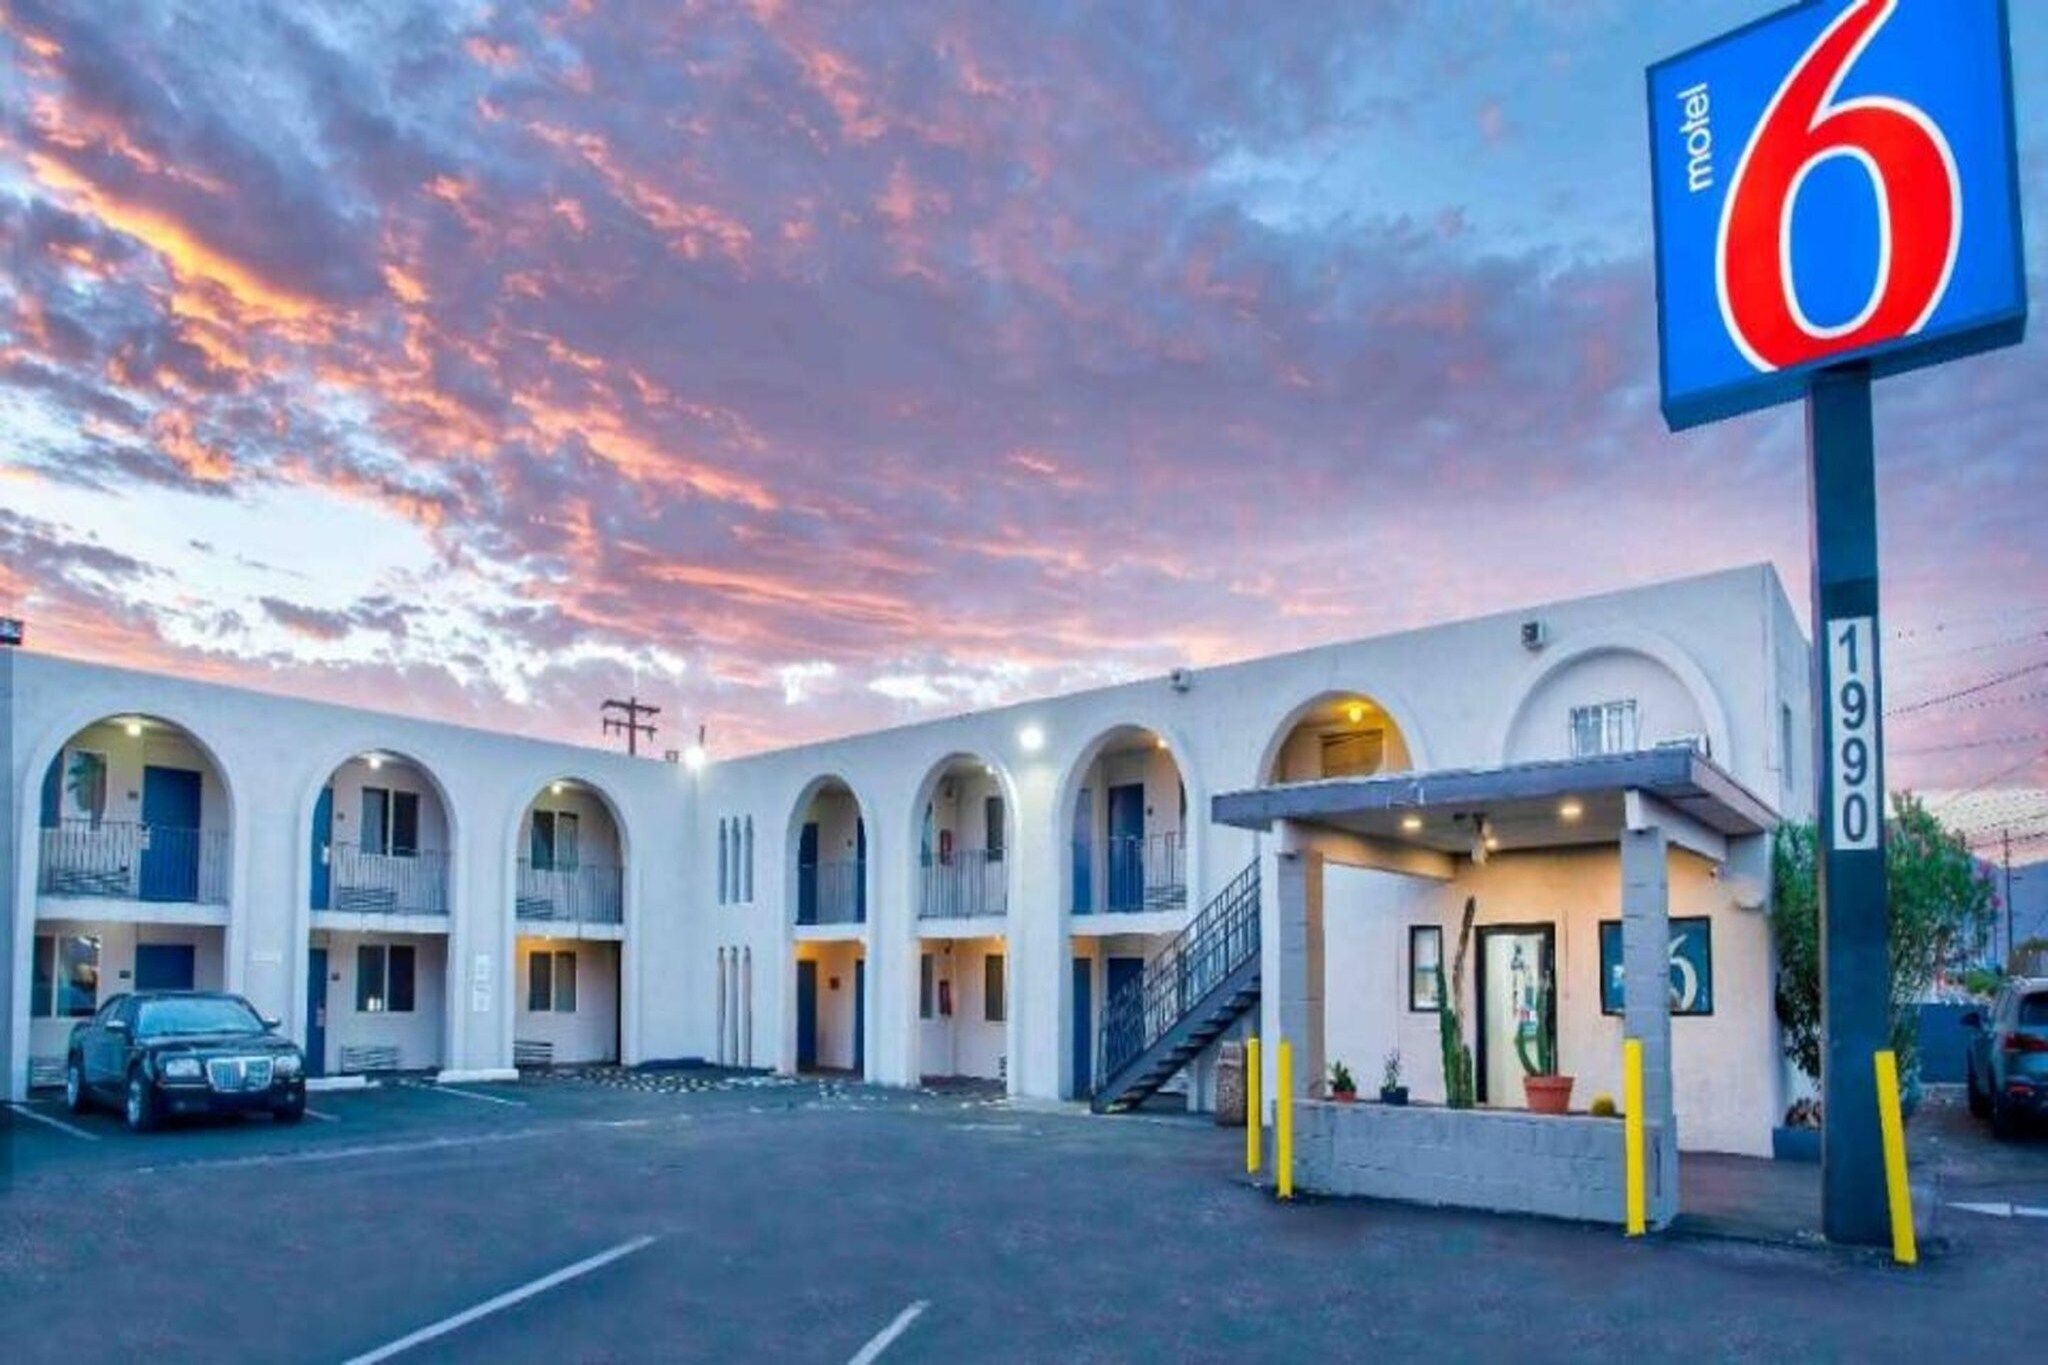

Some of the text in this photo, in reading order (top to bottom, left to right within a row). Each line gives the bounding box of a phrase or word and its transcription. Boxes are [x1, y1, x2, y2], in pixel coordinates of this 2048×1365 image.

[1677, 83, 1713, 192] motel
[1715, 0, 1962, 372] 6
[1838, 624, 1868, 842] 1990
